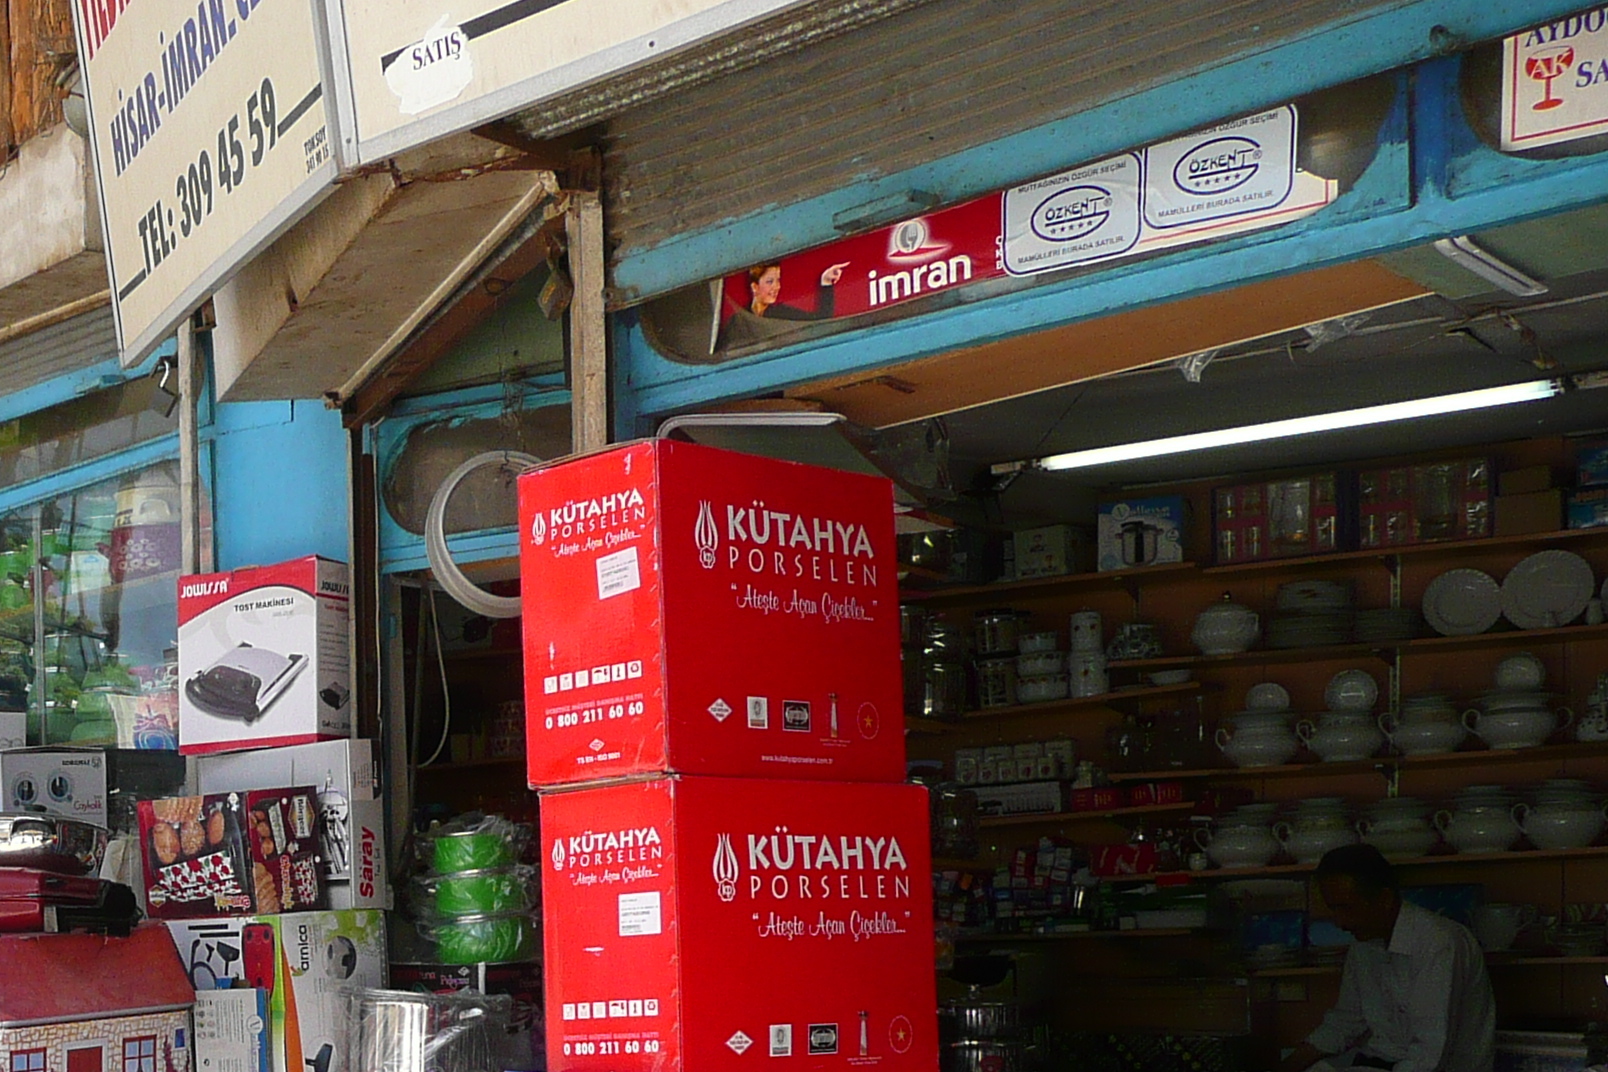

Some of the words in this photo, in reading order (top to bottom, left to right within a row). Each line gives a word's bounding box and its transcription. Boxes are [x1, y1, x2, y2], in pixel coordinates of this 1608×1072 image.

[1525, 8, 1608, 48] AYDO
[412, 32, 461, 71] SATIŞ
[1189, 147, 1255, 173] ÖZKENT
[138, 199, 177, 276] TEL:
[177, 150, 212, 238] 309
[218, 114, 244, 194] 45
[247, 77, 276, 167] 59
[1045, 195, 1106, 223] ÖZKENT
[868, 255, 972, 306] imran
[551, 487, 644, 527] KÜTAHYA
[551, 506, 645, 541] PORSELEN
[727, 500, 874, 559] KÜTAHYA
[729, 546, 877, 587] PORSELEN
[180, 580, 228, 599] JOWISSA
[783, 589, 817, 618] Açan
[234, 603, 254, 612] TOST
[545, 716, 553, 730] 0
[557, 712, 578, 728] 800
[582, 708, 603, 723] 211
[609, 705, 623, 719] 60
[628, 701, 644, 716] 60
[569, 826, 661, 855] KÜTAHYA
[747, 826, 907, 870] KÜTAHYA
[359, 826, 376, 898] Saray
[569, 846, 662, 869] PORSELEN
[750, 875, 909, 899] PORSELEN
[809, 911, 845, 940] Açan
[563, 1043, 571, 1056] 0
[575, 1041, 595, 1055] 800
[599, 1041, 619, 1054] 211
[624, 1040, 640, 1054] 60
[644, 1039, 659, 1053] 60
